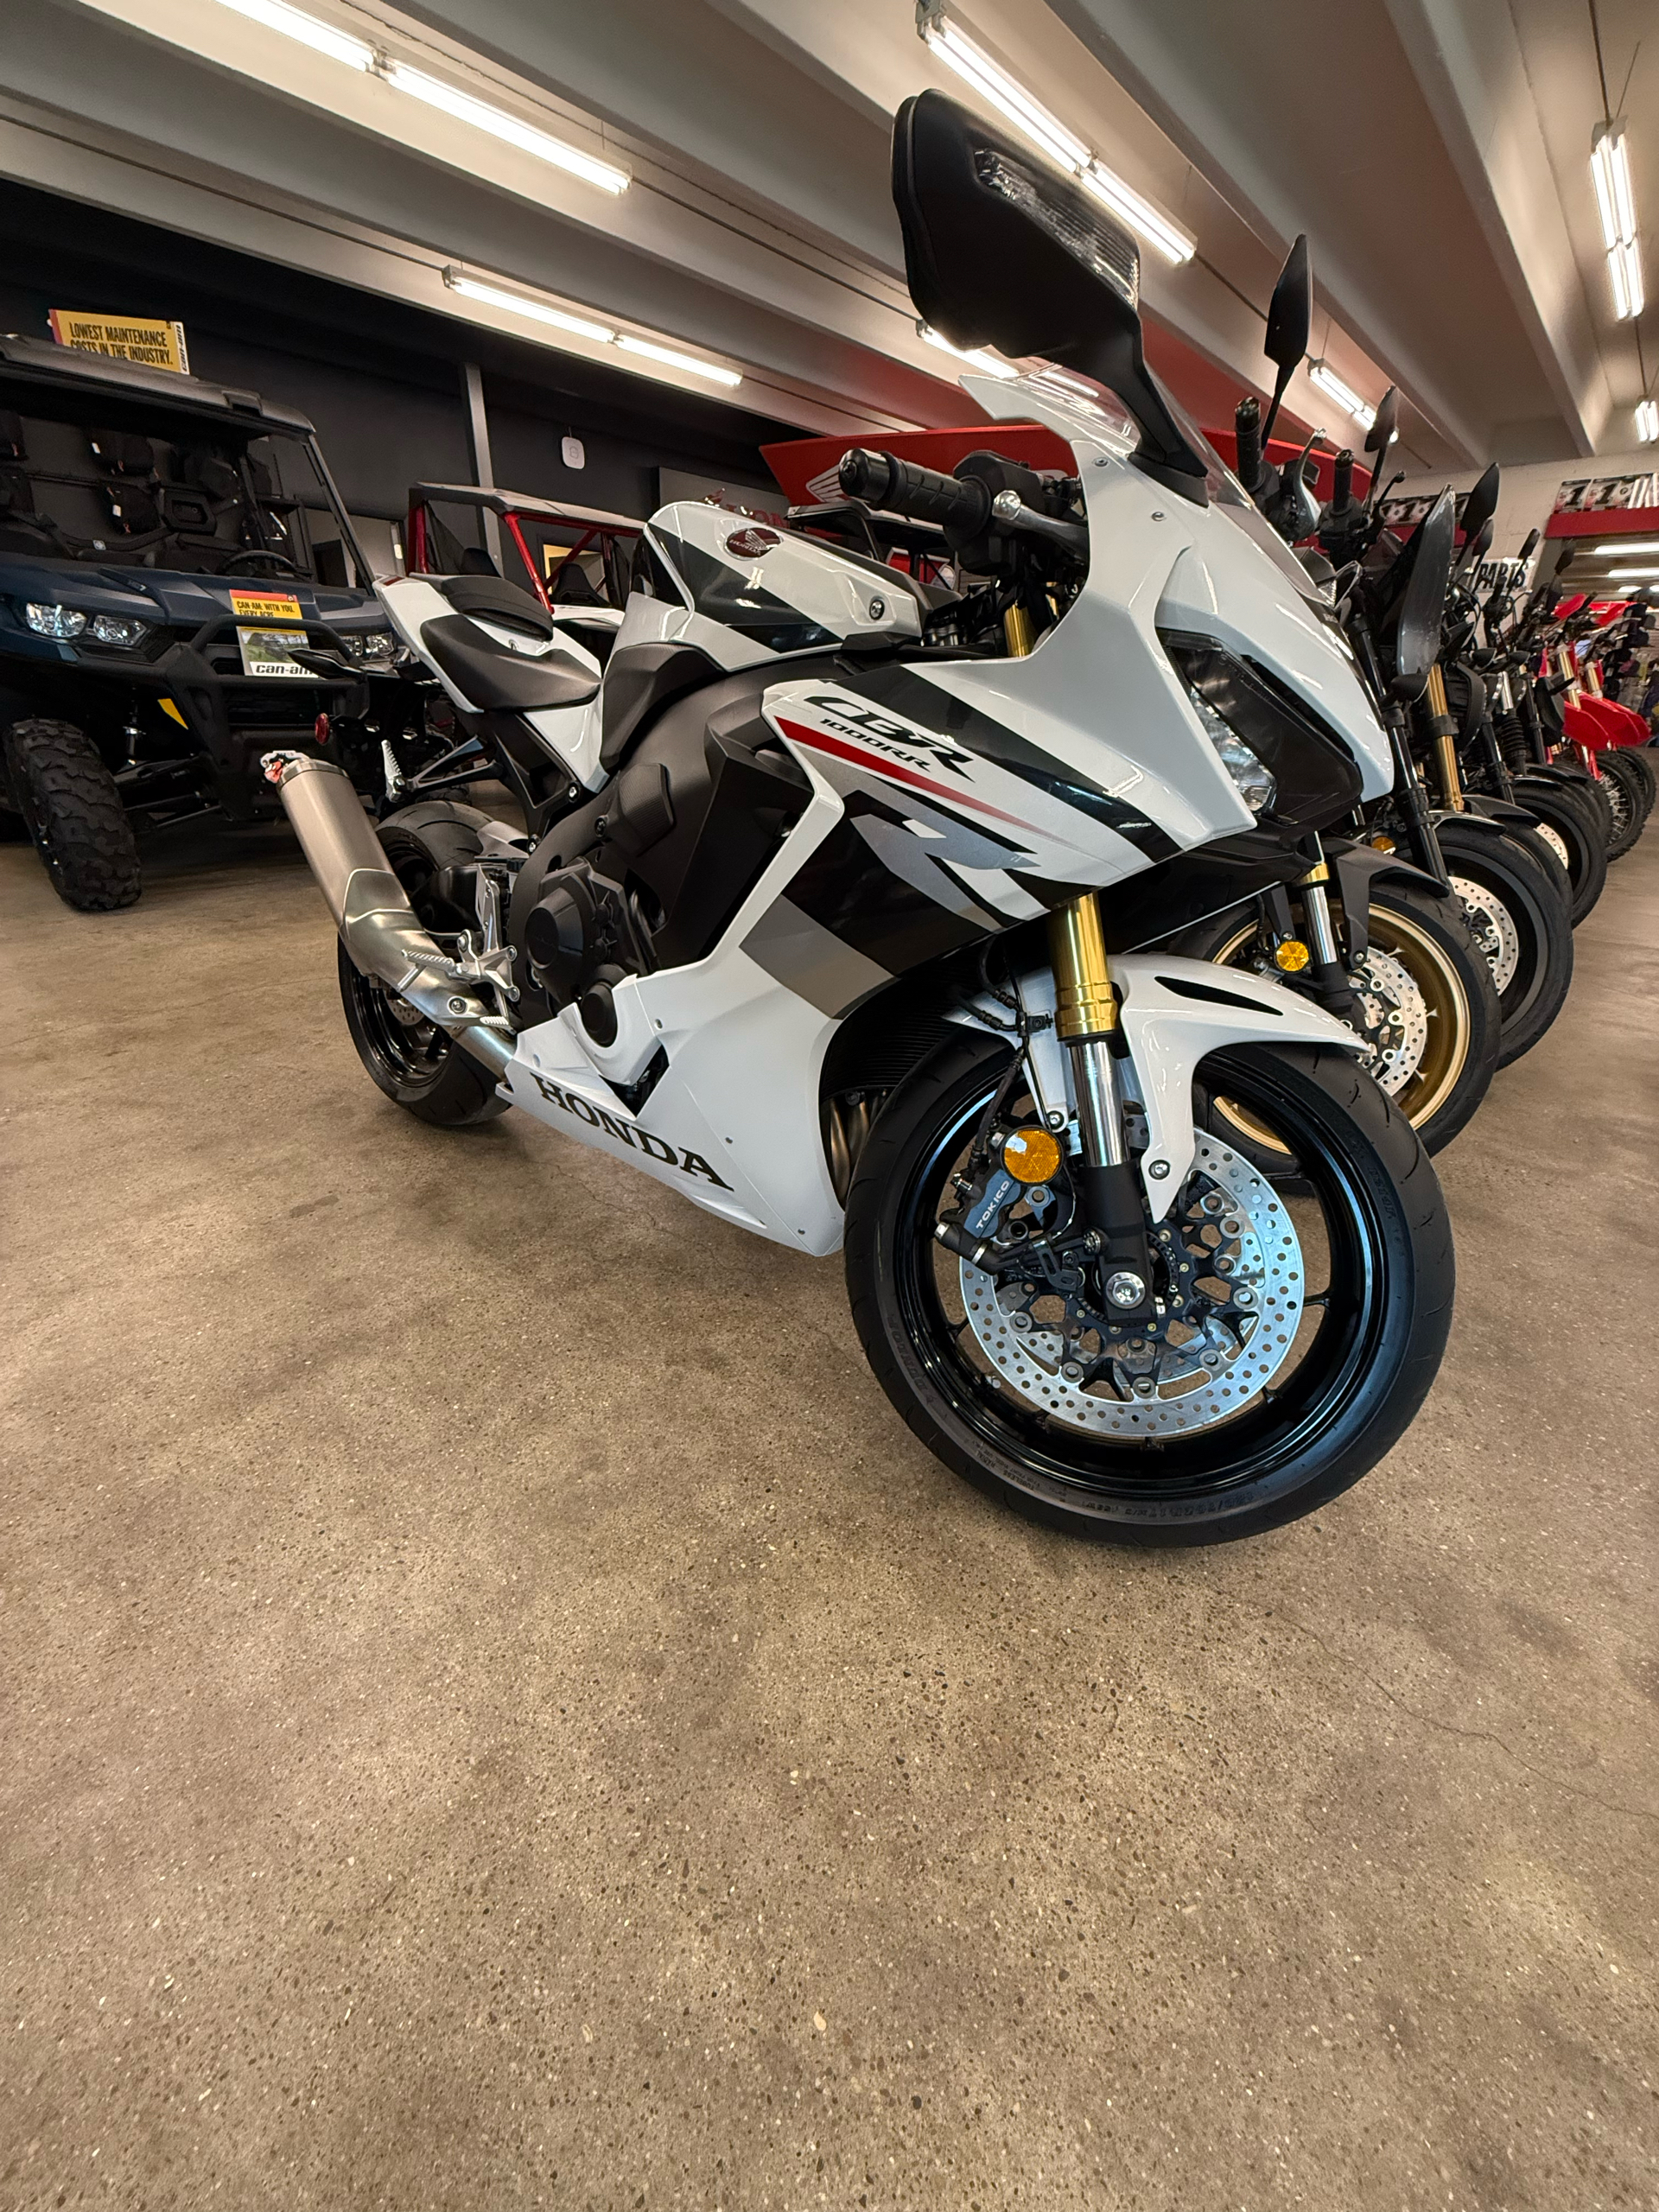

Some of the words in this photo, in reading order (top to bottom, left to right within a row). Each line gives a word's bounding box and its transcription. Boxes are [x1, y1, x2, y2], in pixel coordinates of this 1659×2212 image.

[69, 321, 103, 340] LOWEST
[105, 326, 168, 346] MAINTENANCE
[99, 342, 109, 355] IN
[110, 344, 128, 359] THE
[129, 346, 173, 365] INDUSTRY.
[1475, 562, 1529, 588] PARTS
[264, 603, 279, 612] WITH
[804, 696, 976, 783] CBR
[820, 718, 931, 772] 1000RR
[530, 1071, 734, 1192] HONDA
[976, 1180, 1010, 1229] TOKICO
[1003, 1470, 1035, 1491] TUBELESS
